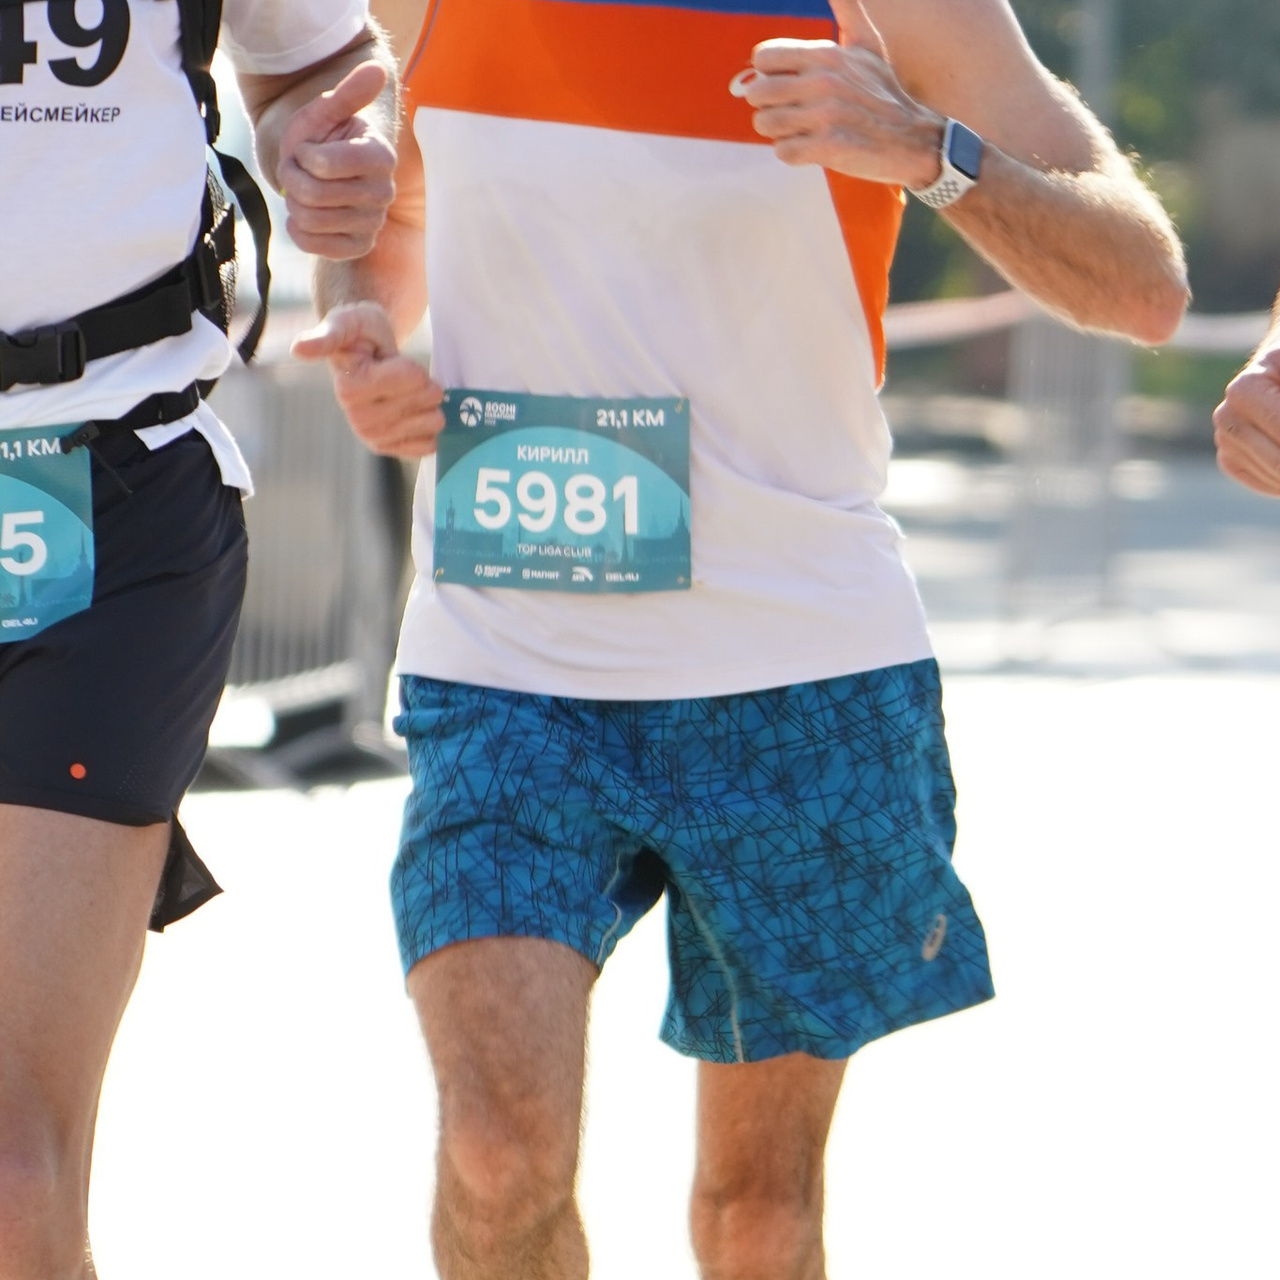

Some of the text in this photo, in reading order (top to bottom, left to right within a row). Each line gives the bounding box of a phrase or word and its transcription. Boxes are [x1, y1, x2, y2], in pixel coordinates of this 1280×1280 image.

[596, 408, 664, 429] 21,1 KM
[27, 437, 61, 457] KM
[517, 445, 589, 465] КИРИЛЛ
[473, 467, 638, 535] 5981
[0, 510, 48, 576] 5
[517, 543, 592, 558] TOP LIGA CLUB
